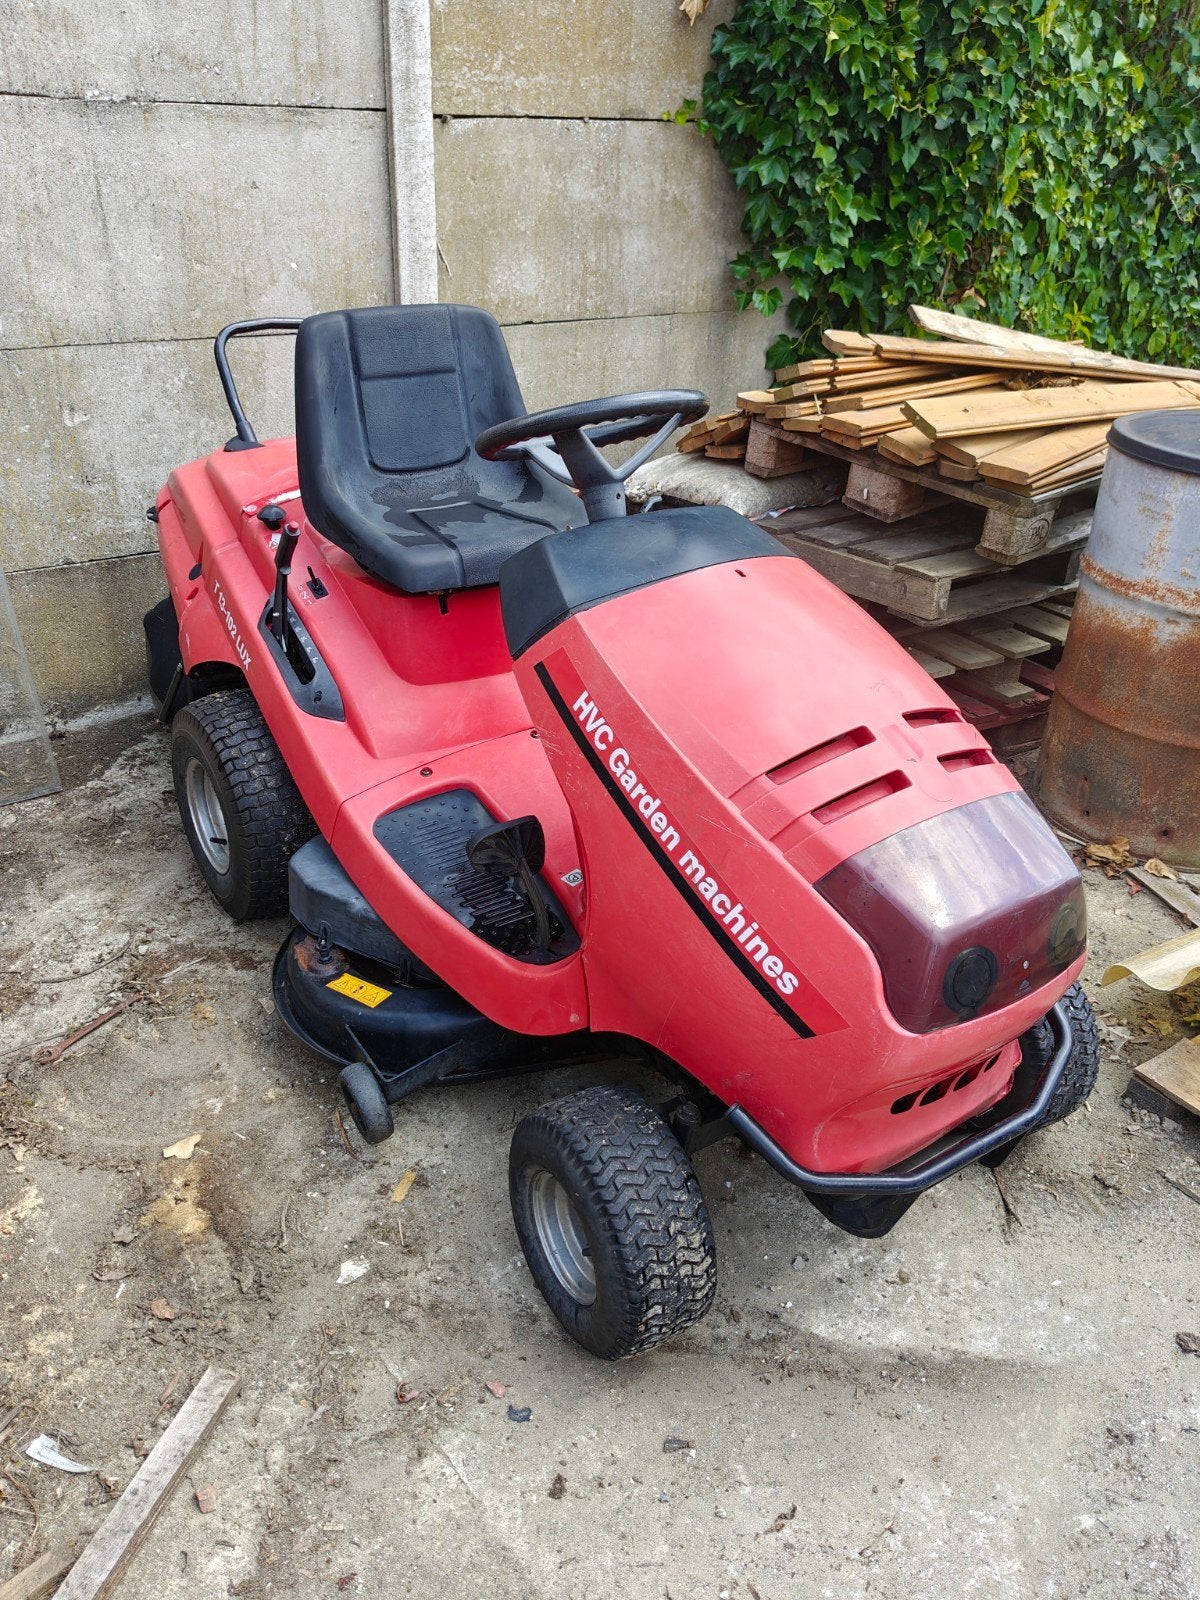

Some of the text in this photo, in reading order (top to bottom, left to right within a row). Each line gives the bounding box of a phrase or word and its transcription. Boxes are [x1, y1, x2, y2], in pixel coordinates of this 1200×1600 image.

[213, 580, 252, 672] T 13-102 LUX
[572, 690, 799, 995] HVC Garden machines
